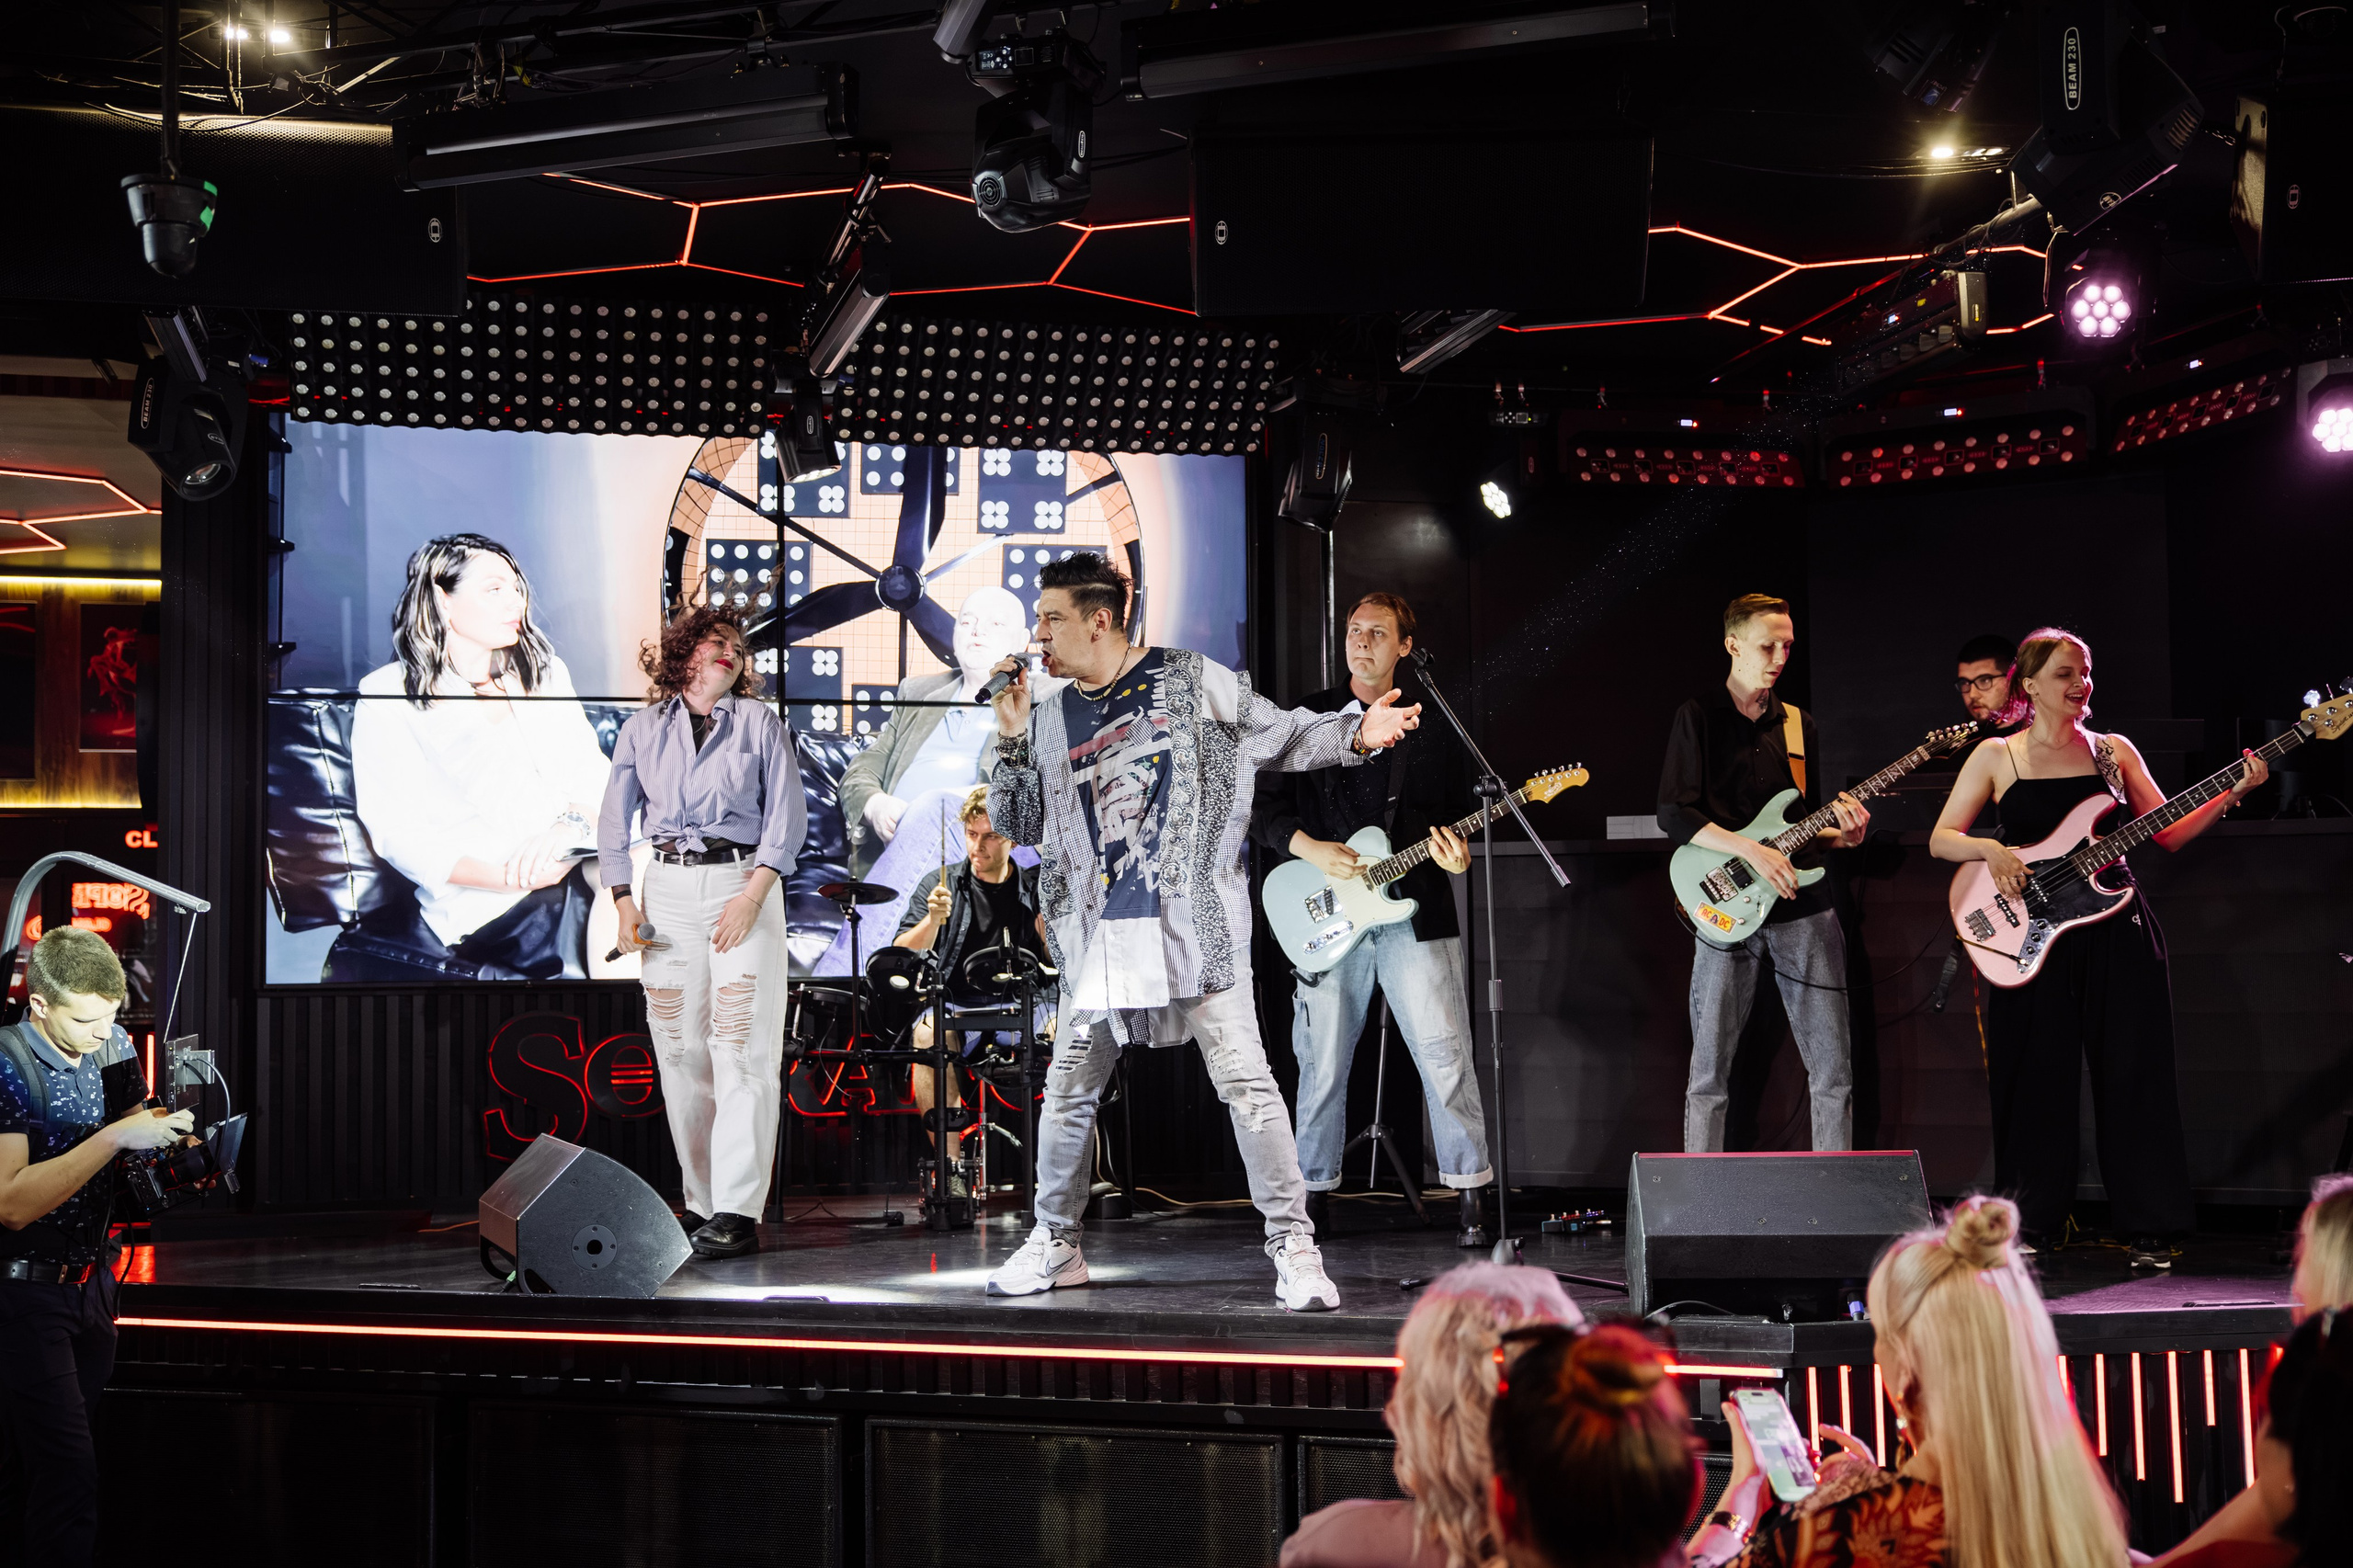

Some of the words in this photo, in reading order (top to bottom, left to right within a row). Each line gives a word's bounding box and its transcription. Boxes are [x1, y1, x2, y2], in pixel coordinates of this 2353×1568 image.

[2067, 38, 2076, 60] 230
[2068, 62, 2077, 99] BEAM
[145, 384, 153, 399] 230
[142, 400, 151, 423] BEAM
